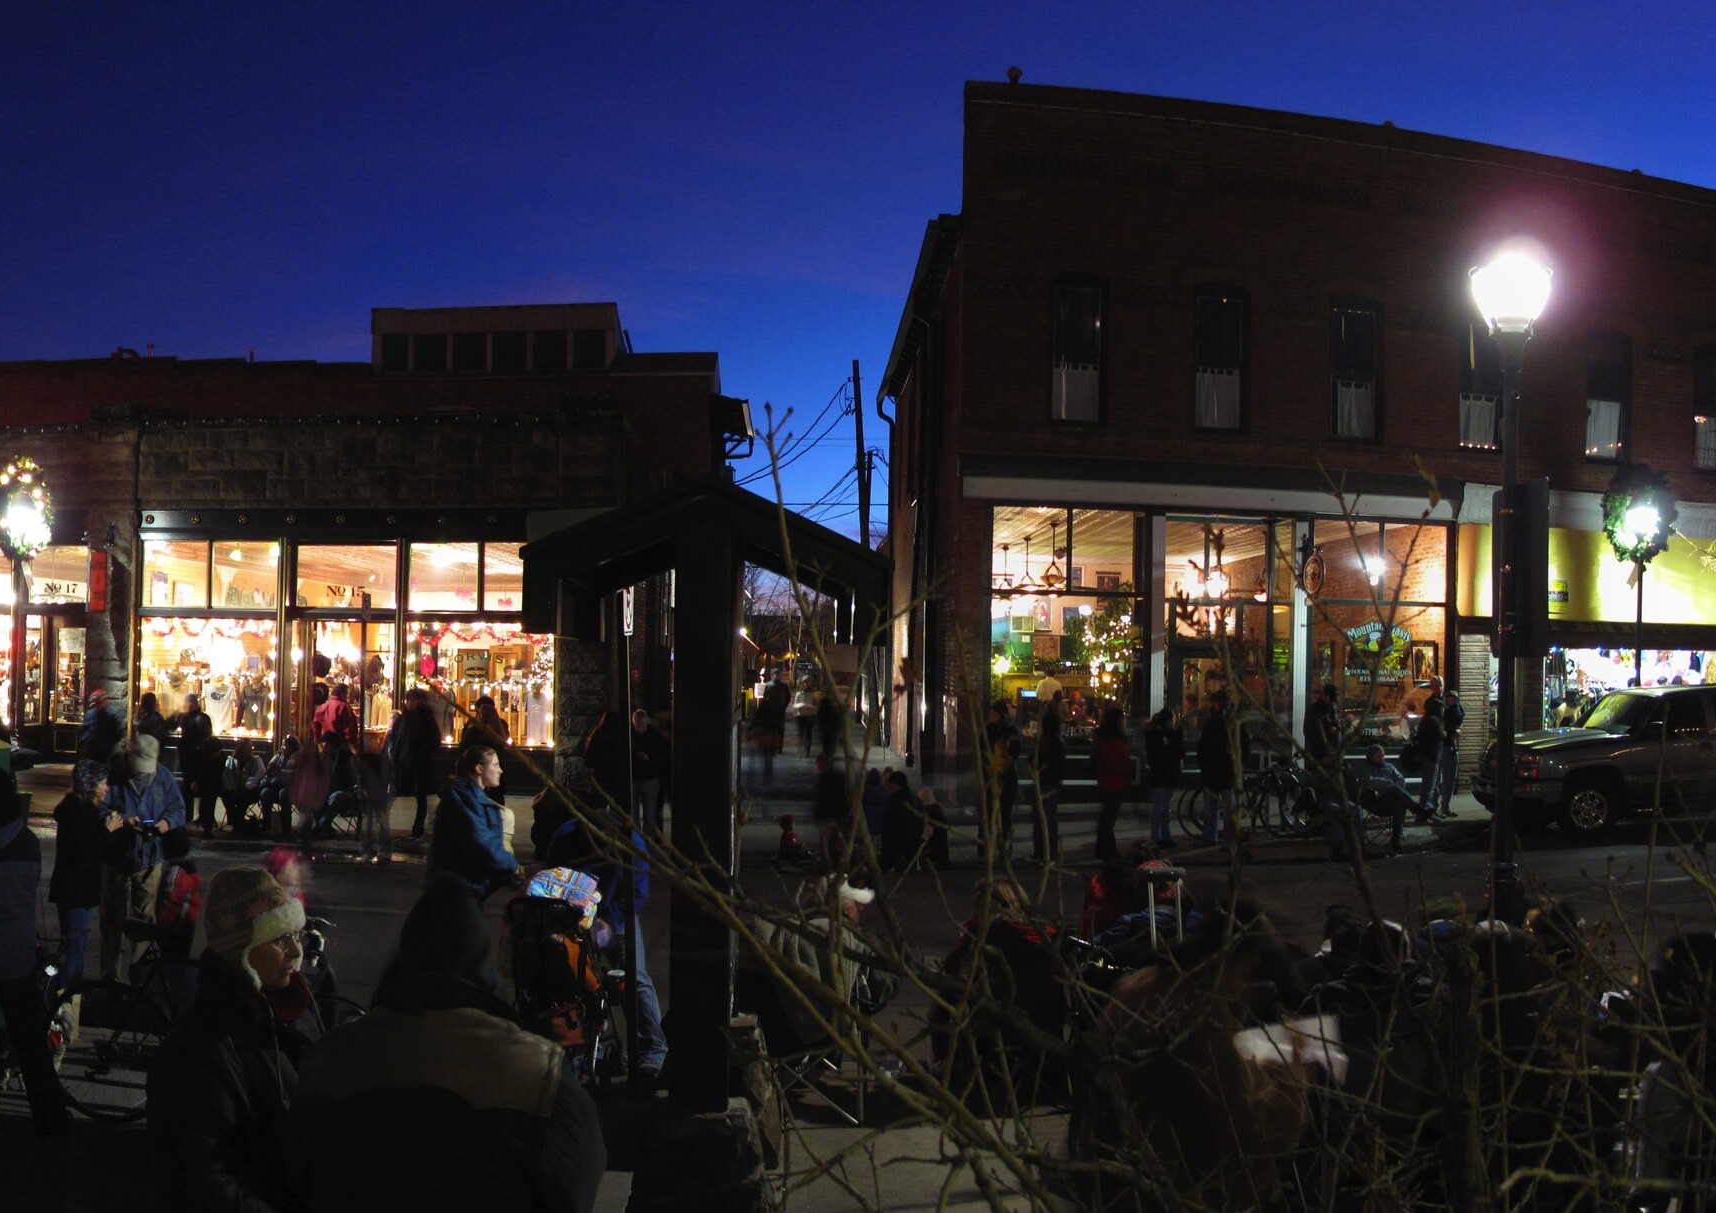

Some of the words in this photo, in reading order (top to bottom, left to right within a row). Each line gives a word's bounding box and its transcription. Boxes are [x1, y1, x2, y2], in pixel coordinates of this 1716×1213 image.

[66, 584, 78, 593] 17
[351, 586, 366, 597] 15
[454, 651, 505, 664] ORVIS
